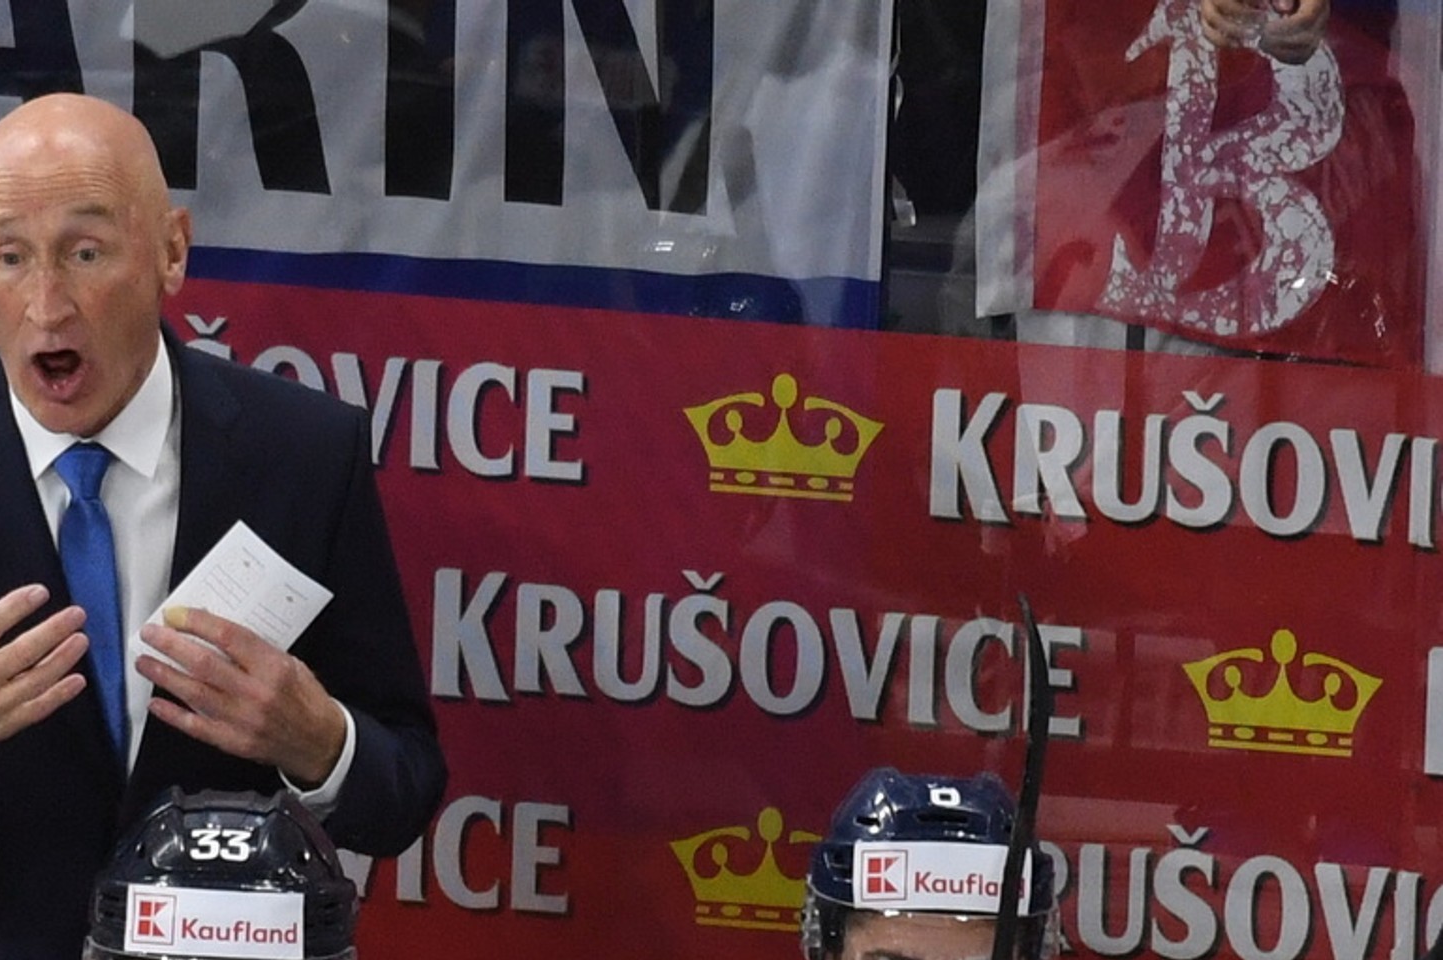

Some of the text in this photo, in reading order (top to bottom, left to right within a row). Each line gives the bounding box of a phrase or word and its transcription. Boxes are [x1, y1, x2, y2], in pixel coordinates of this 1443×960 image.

[430, 567, 1082, 736] KRUŠOVICE
[189, 828, 253, 862] 33
[180, 917, 298, 945] Kaufland
